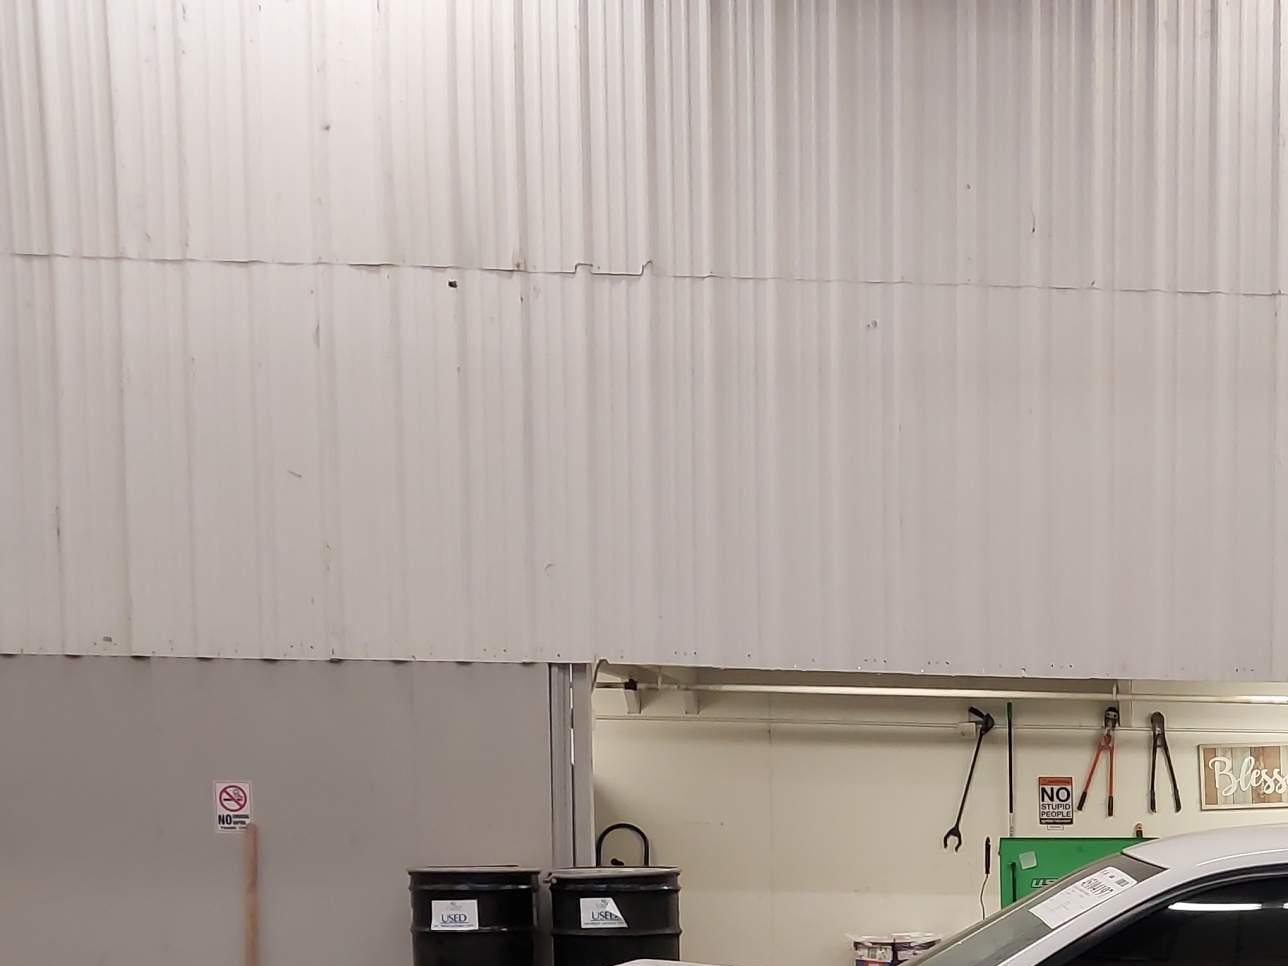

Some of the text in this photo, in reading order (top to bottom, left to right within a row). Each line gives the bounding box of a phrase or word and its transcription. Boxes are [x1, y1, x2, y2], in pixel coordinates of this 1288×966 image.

[1041, 786, 1071, 802] NO
[1041, 803, 1071, 811] STUPID
[218, 814, 232, 825] NO
[441, 913, 468, 923] USED
